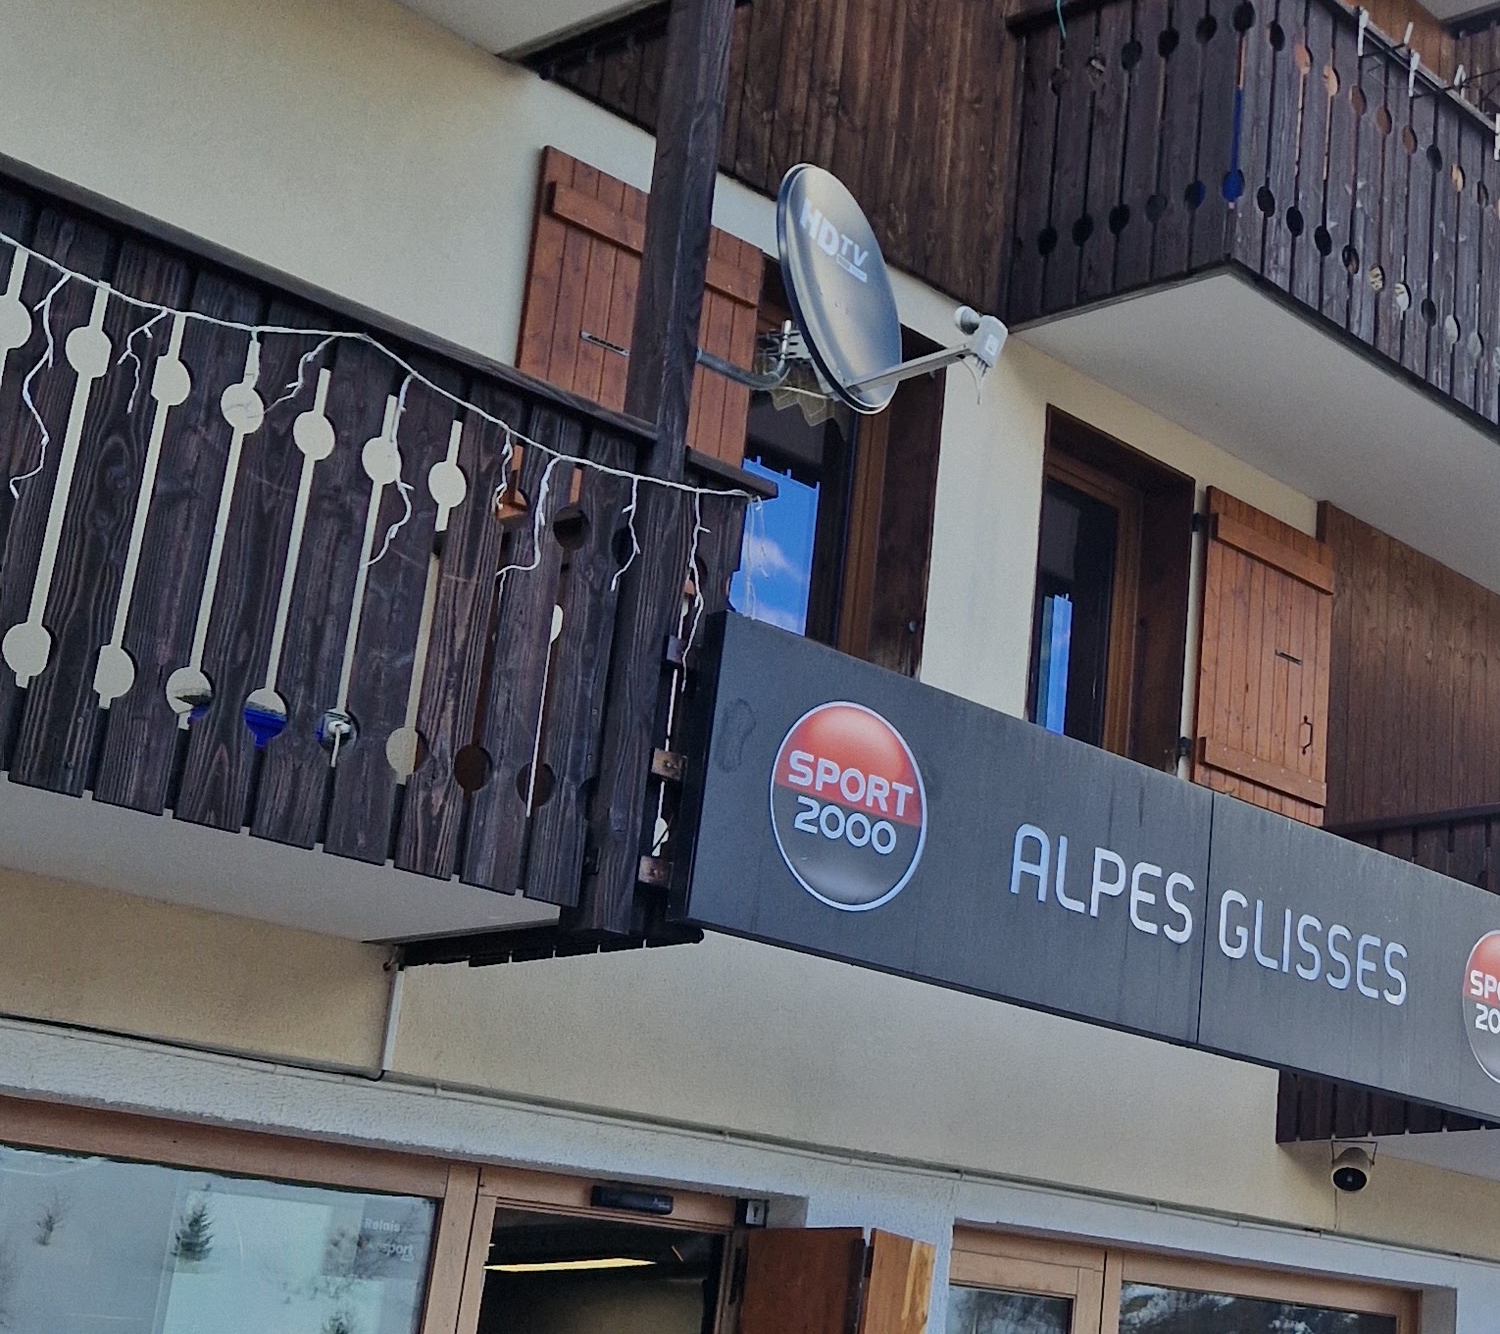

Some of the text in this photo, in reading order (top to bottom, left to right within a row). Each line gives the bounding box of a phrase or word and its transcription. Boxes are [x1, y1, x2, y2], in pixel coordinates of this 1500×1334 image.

[788, 750, 915, 817] SPORT
[794, 795, 897, 856] 2000
[1008, 823, 1409, 1007] ALPES GLISSES
[364, 1218, 401, 1233] Relais
